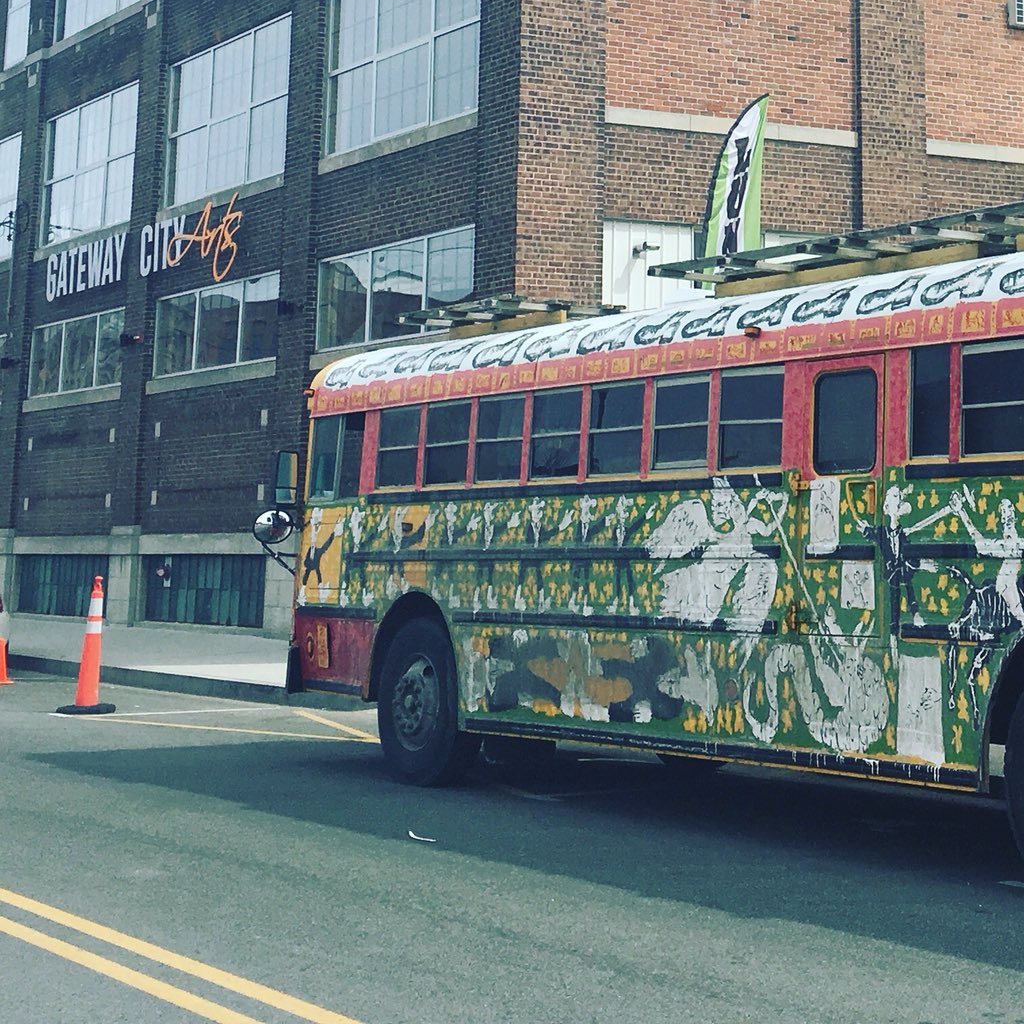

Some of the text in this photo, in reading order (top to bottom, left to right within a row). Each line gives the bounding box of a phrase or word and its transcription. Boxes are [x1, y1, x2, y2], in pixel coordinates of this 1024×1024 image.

[45, 191, 244, 303] GATEWAY CITY Arts
